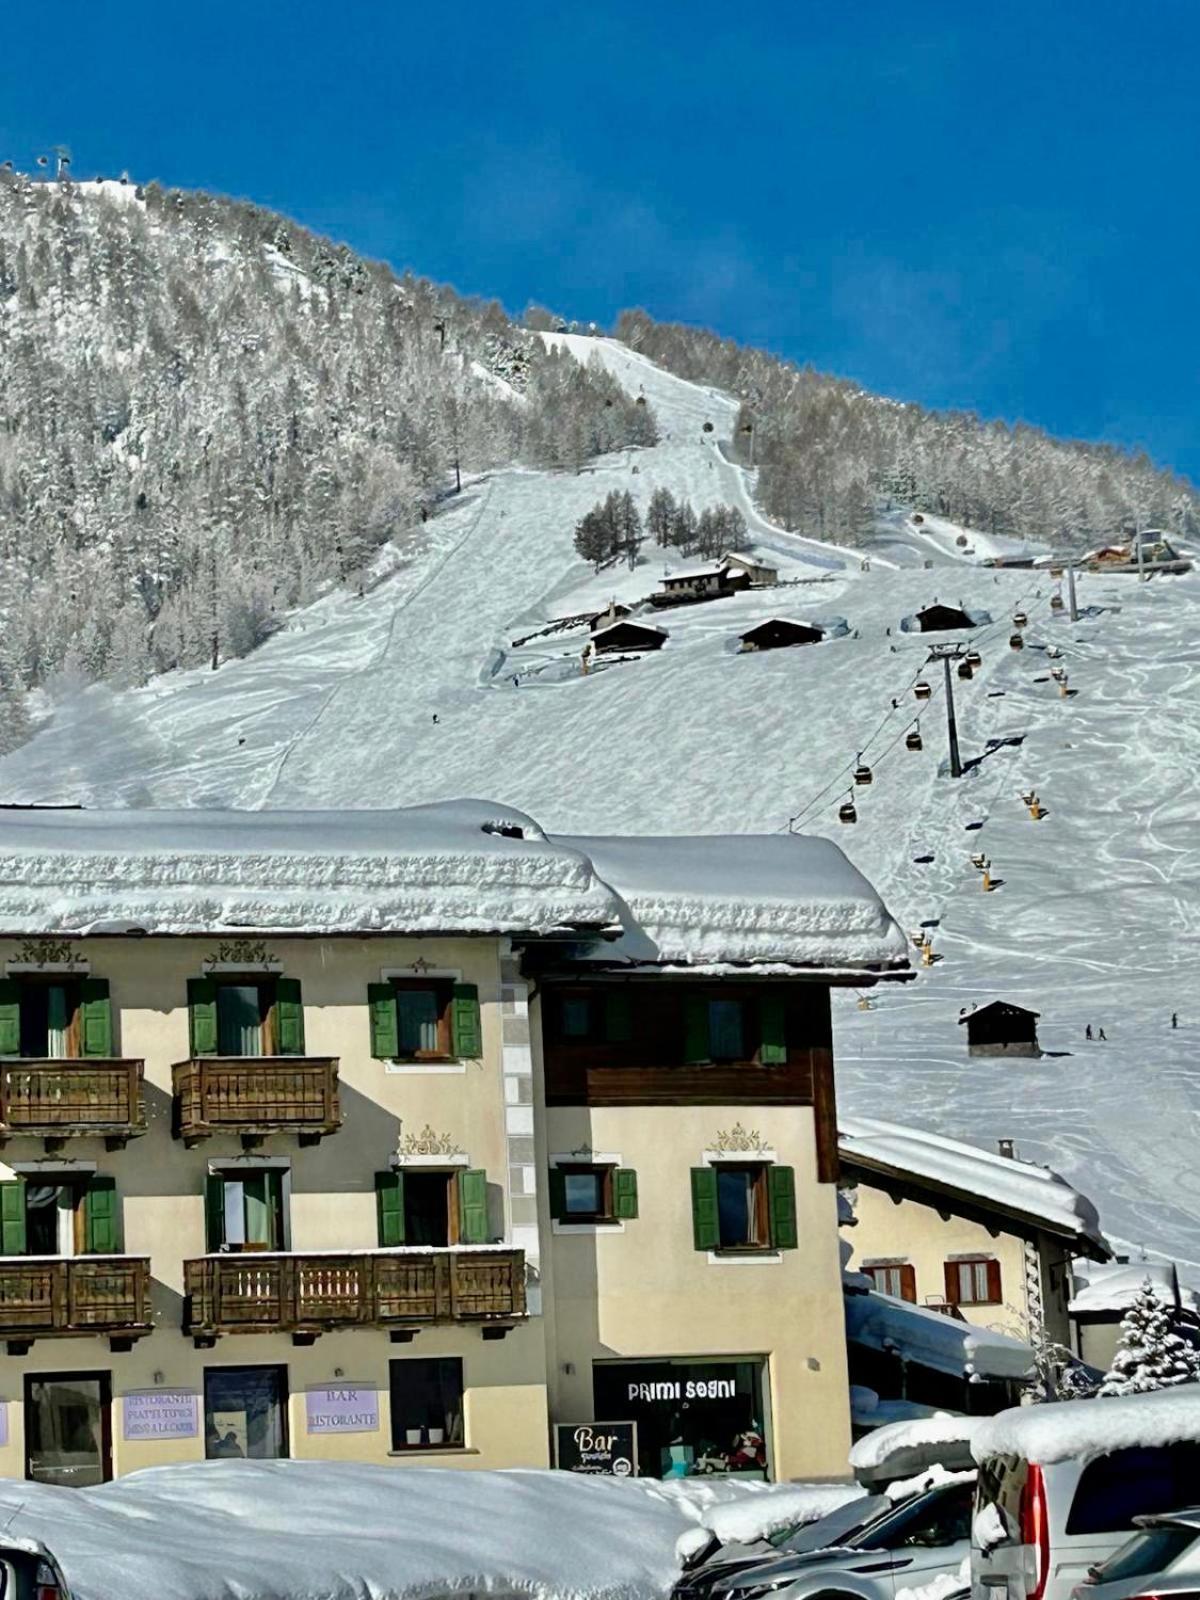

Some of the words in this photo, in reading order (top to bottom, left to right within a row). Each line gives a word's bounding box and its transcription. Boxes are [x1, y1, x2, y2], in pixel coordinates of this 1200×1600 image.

[326, 1389, 358, 1402] BAR
[307, 1414, 377, 1427] RISTORANTE
[574, 1427, 618, 1452] Bar
